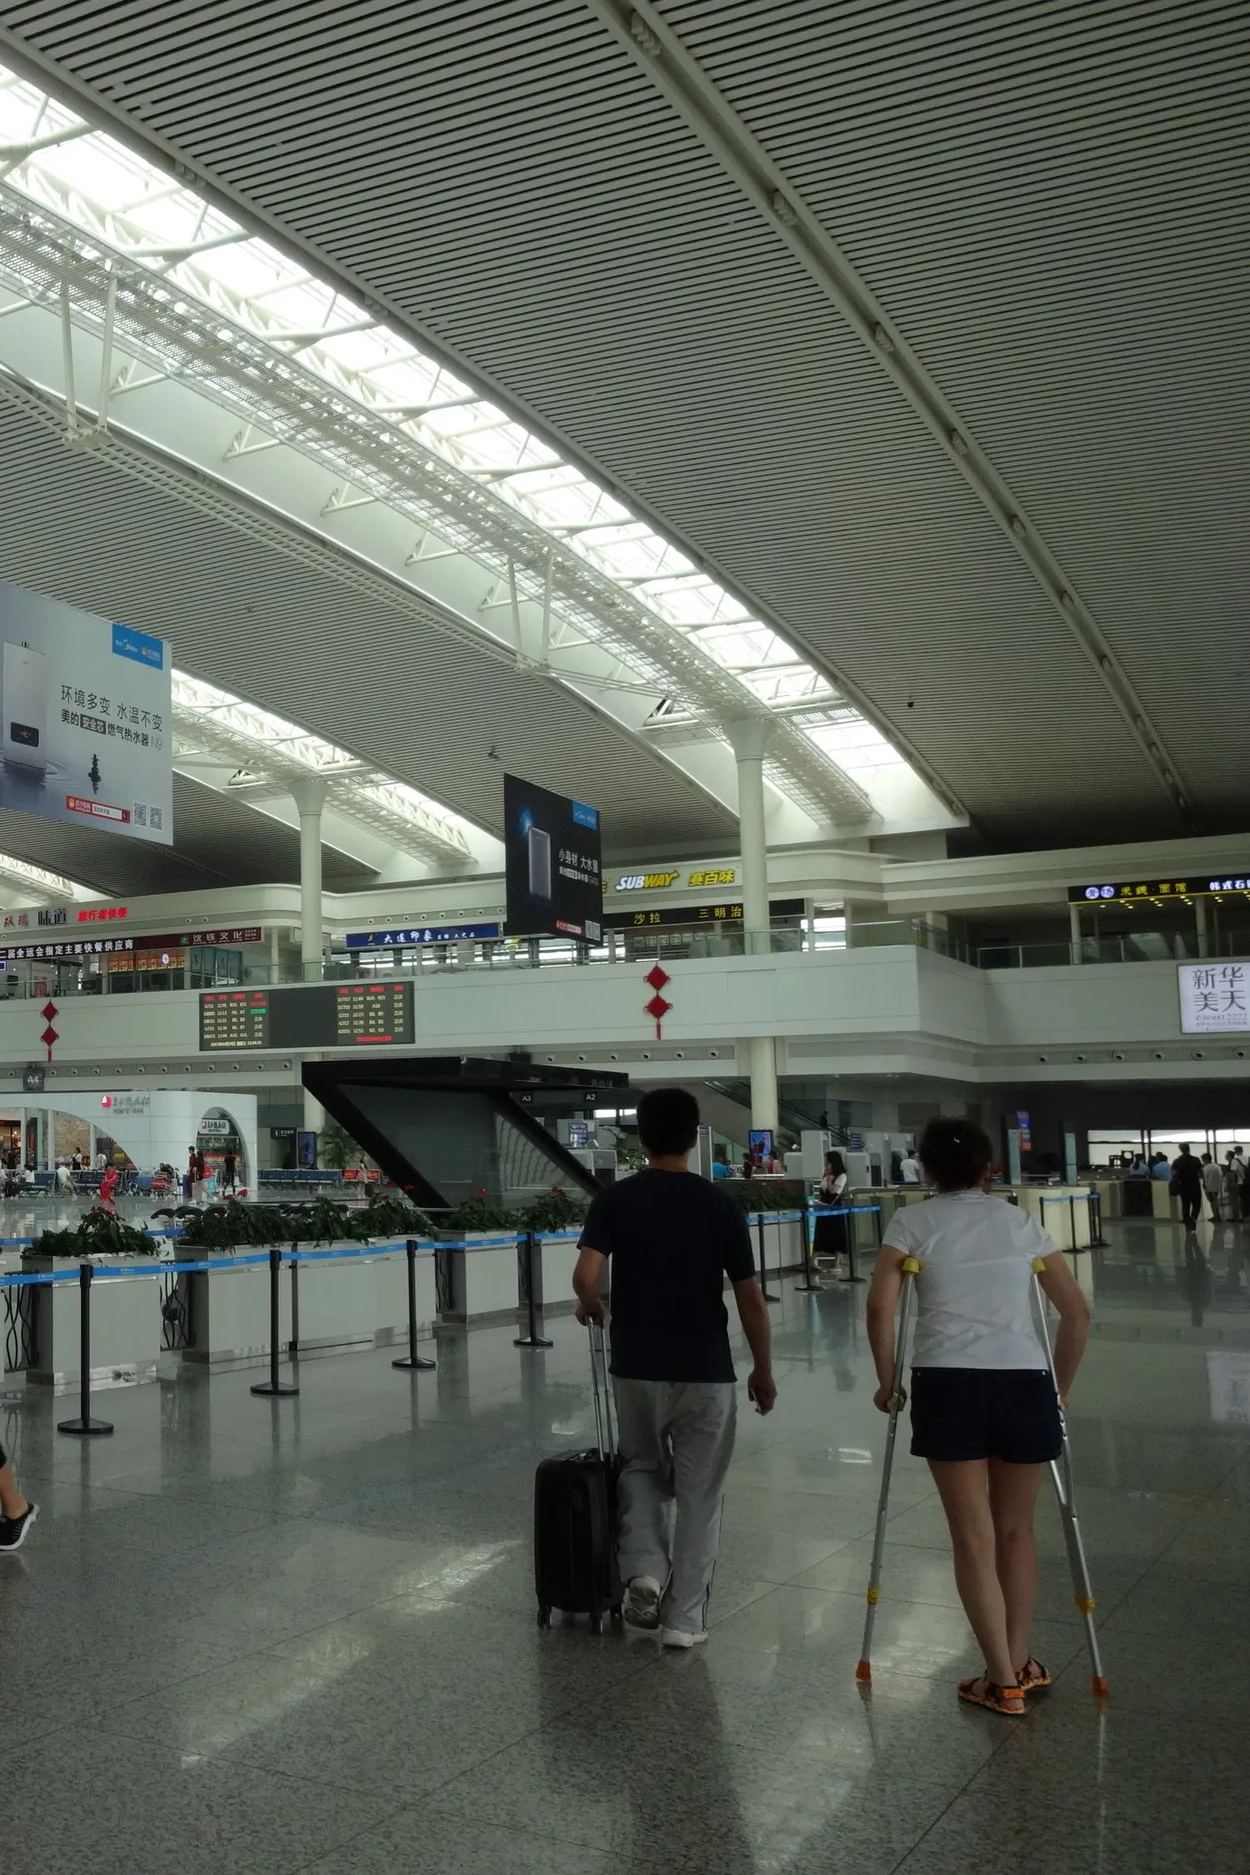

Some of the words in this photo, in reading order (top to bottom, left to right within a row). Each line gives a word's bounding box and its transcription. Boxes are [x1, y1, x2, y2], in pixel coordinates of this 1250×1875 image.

[61, 685, 110, 716] 环境多变
[117, 702, 162, 732] 水温不变
[559, 848, 578, 867] 小身材
[580, 856, 599, 873] 大水量
[615, 870, 679, 891] SUBWAY
[689, 869, 735, 887] 赛百味
[1209, 880, 1250, 891] 韩式石
[37, 908, 67, 926] 味道
[634, 913, 661, 925] 沙拉
[698, 906, 742, 918] 三明治
[1192, 966, 1245, 990] 新华
[1194, 990, 1246, 1013] 美天
[27, 1075, 39, 1083] A4
